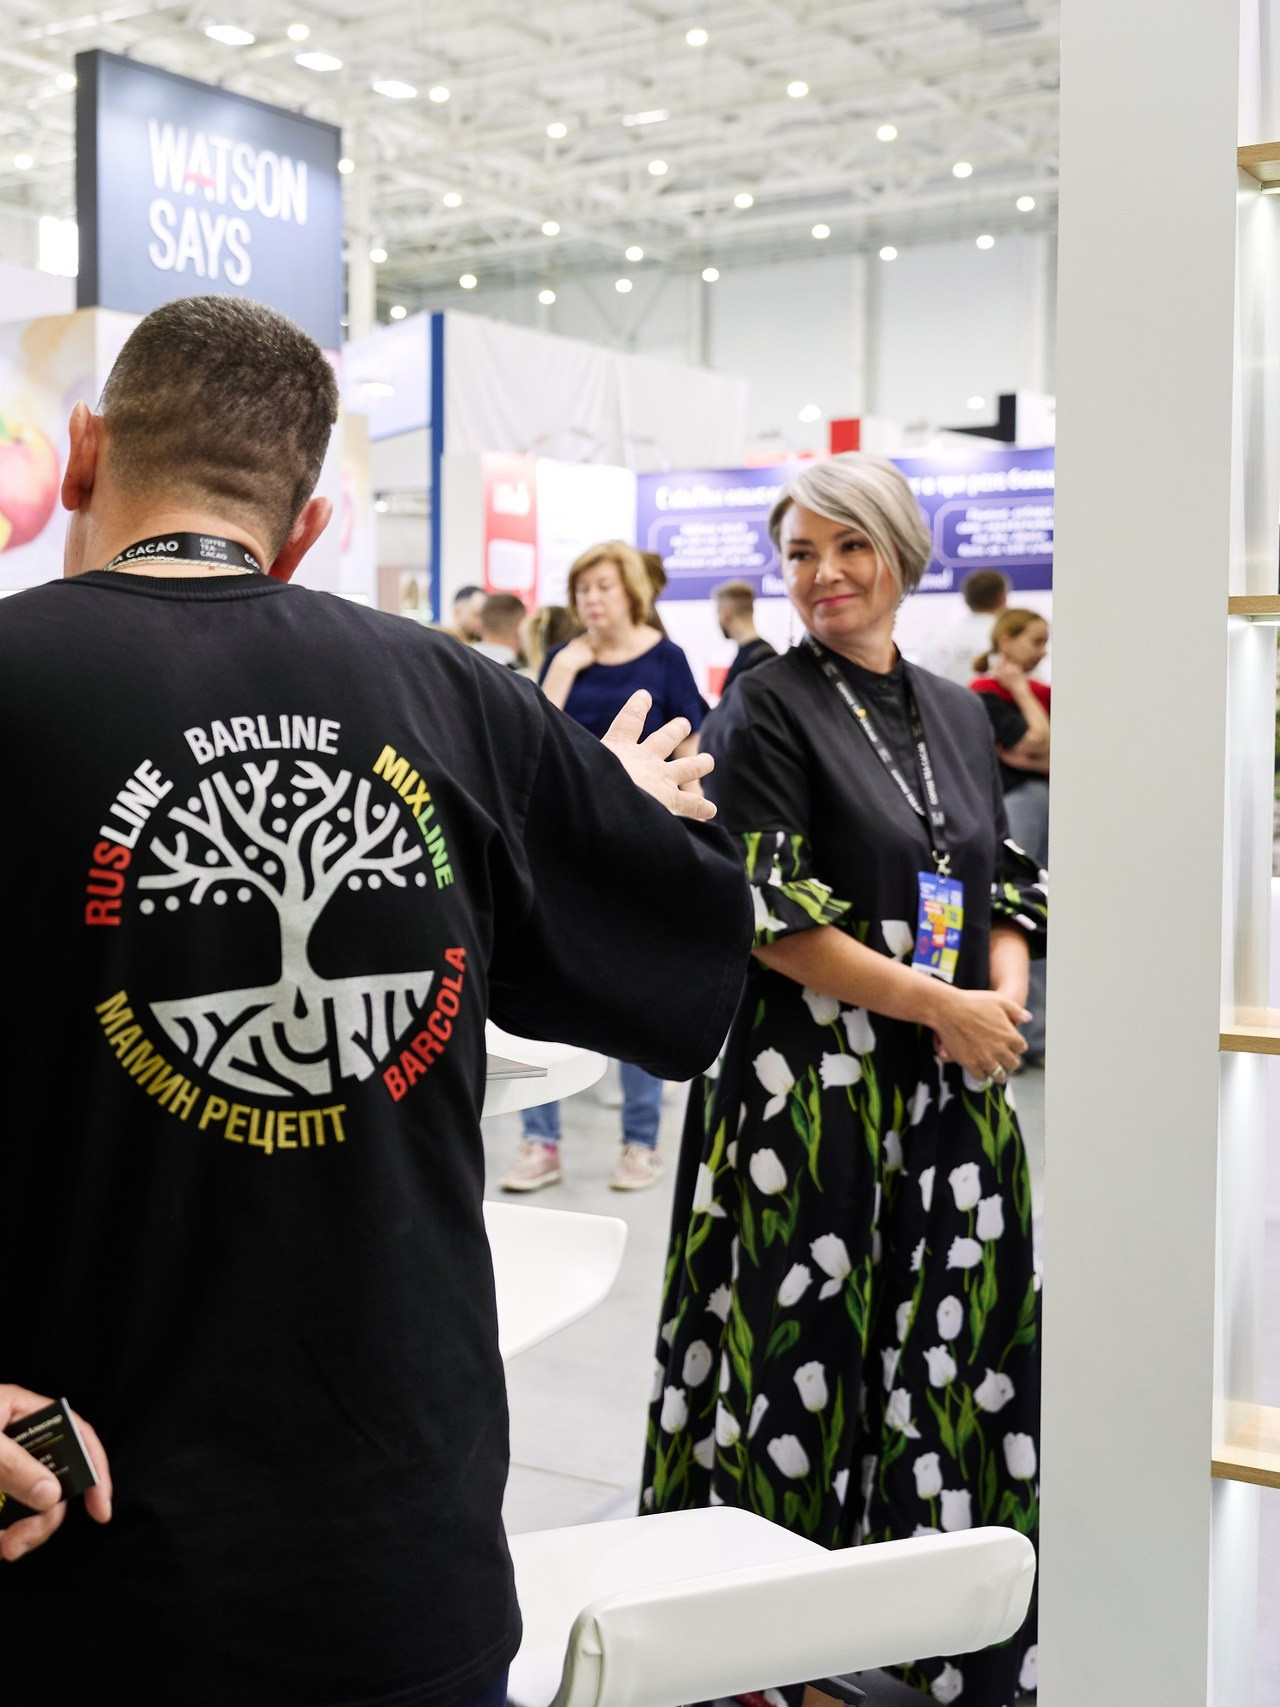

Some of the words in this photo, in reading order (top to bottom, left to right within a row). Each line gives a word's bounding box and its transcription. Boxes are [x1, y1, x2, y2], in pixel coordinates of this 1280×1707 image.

[148, 118, 307, 225] WATSON
[148, 199, 252, 286] SAYS
[126, 541, 179, 558] CACAO
[200, 537, 226, 548] COFFEE
[200, 550, 228, 561] CACAO
[183, 714, 341, 765] BARLINE
[85, 759, 174, 926] RUSLINE
[372, 744, 454, 889] MIXLINE
[95, 990, 200, 1120] МАМИН
[198, 1095, 347, 1154] РЕЦЕПТ
[383, 947, 466, 1102] BARCOLA
